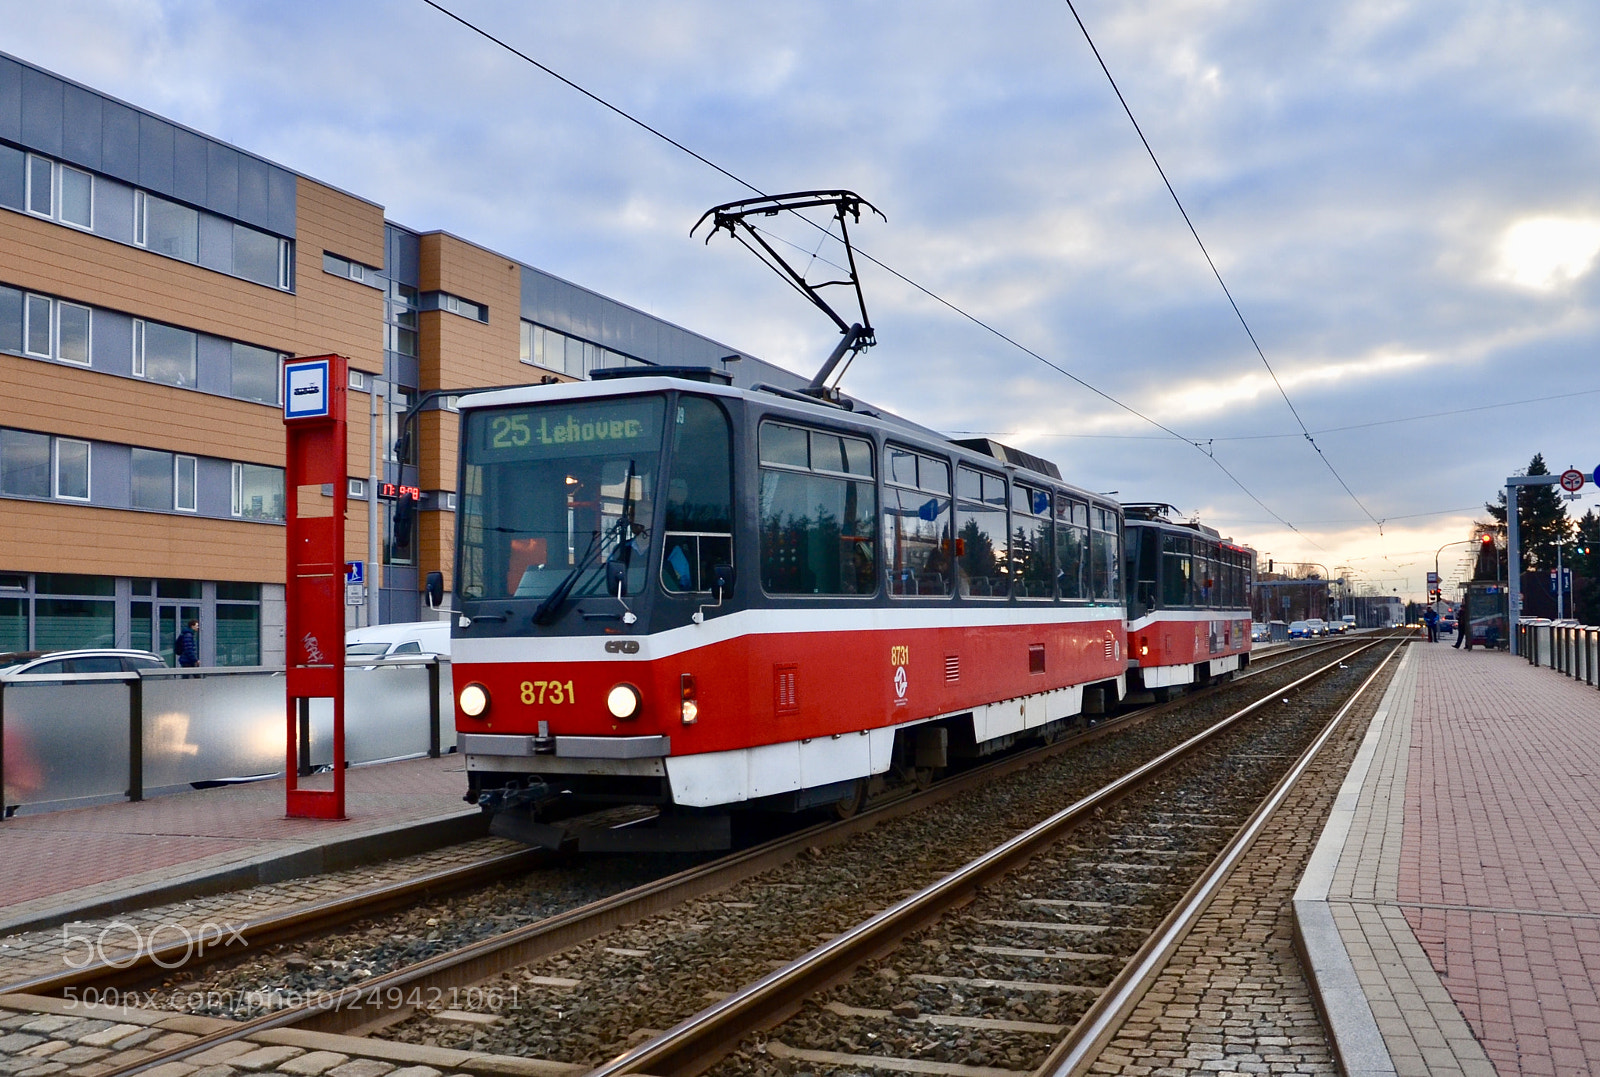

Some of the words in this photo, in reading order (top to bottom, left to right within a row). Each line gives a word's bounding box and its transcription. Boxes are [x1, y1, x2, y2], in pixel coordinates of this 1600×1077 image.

[491, 414, 531, 448] 25
[541, 414, 641, 444] Lehovec
[891, 645, 909, 666] 8731
[520, 680, 575, 705] 8731
